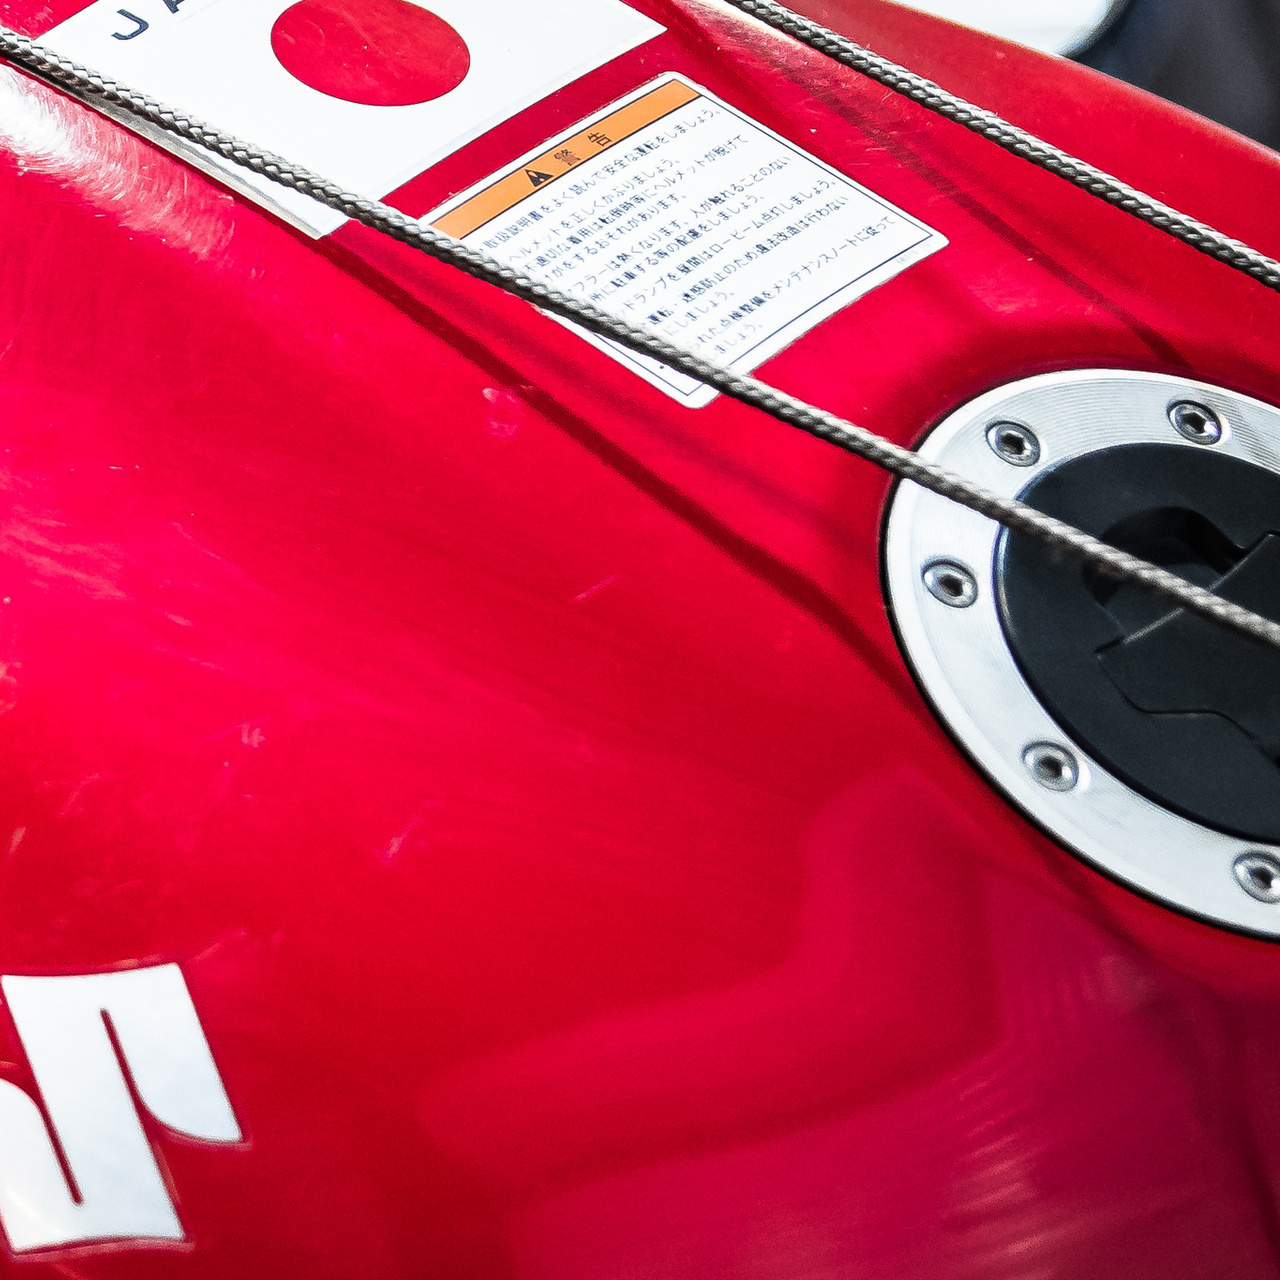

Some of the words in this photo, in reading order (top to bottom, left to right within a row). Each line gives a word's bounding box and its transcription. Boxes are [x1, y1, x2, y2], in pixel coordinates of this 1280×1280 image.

[553, 131, 613, 167] 警告
[567, 156, 791, 293] フラーは熱くなります。人が触れることのない
